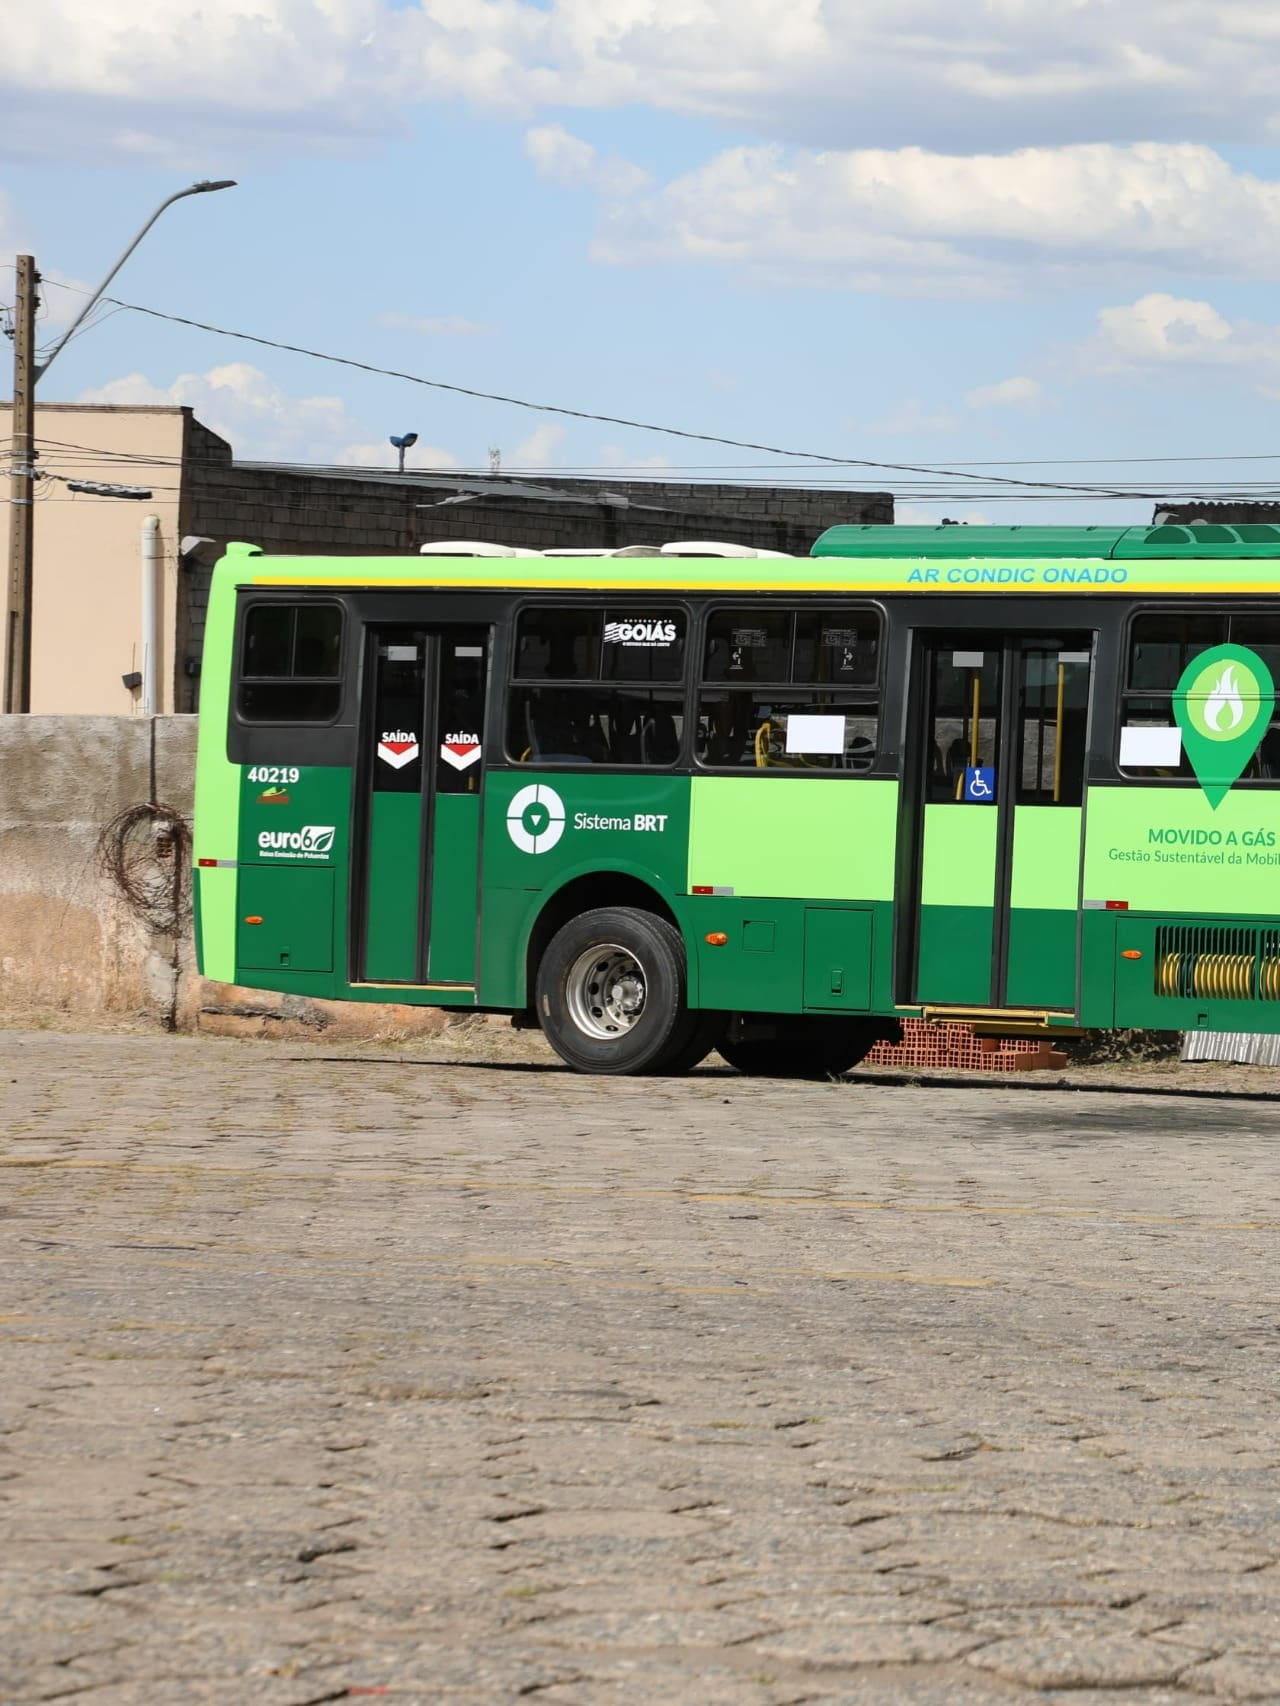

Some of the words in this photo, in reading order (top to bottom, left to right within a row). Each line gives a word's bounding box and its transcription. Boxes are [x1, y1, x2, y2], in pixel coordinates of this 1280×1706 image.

[907, 568, 939, 583] AR
[619, 620, 677, 642] GOIÁS
[382, 729, 417, 743] SAÍDA
[445, 730, 480, 744] SAÍDA
[247, 766, 300, 784] 40219
[574, 812, 631, 830] Sistema
[634, 814, 668, 832] BRT
[1149, 828, 1223, 846] MOVIDO
[1225, 830, 1238, 846] A
[1242, 828, 1276, 847] GÁS
[1108, 848, 1150, 862] Gestão
[1154, 849, 1225, 865] Sustentável
[1227, 852, 1243, 865] da
